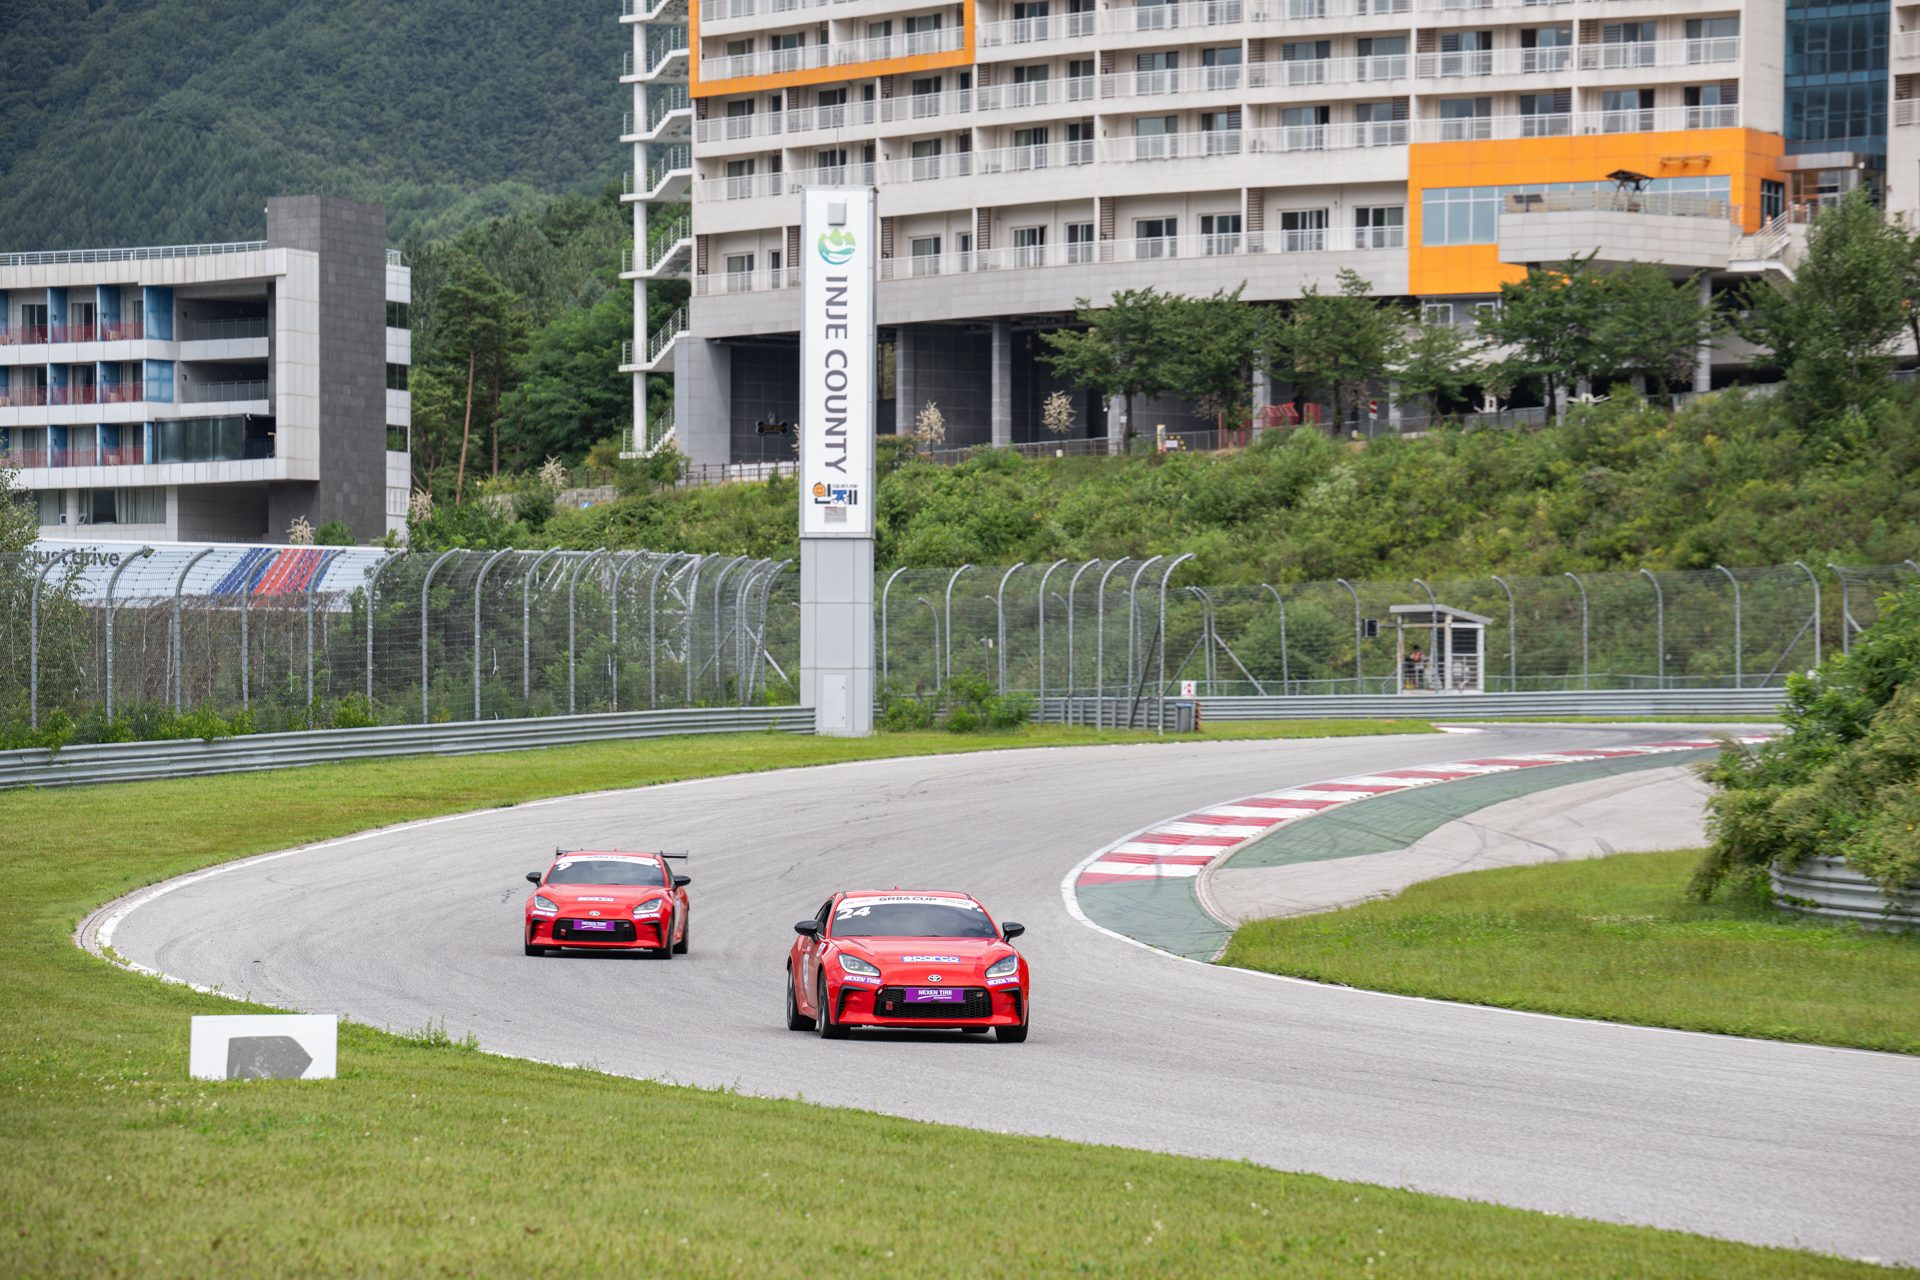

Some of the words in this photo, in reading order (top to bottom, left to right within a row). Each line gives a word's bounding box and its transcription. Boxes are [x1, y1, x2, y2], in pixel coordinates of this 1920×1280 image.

[825, 275, 848, 340] INJE
[825, 349, 848, 474] COUNTY
[71, 547, 120, 567] drive
[836, 906, 871, 920] 24
[843, 975, 866, 983] NEXEN
[866, 977, 882, 985] TIRE
